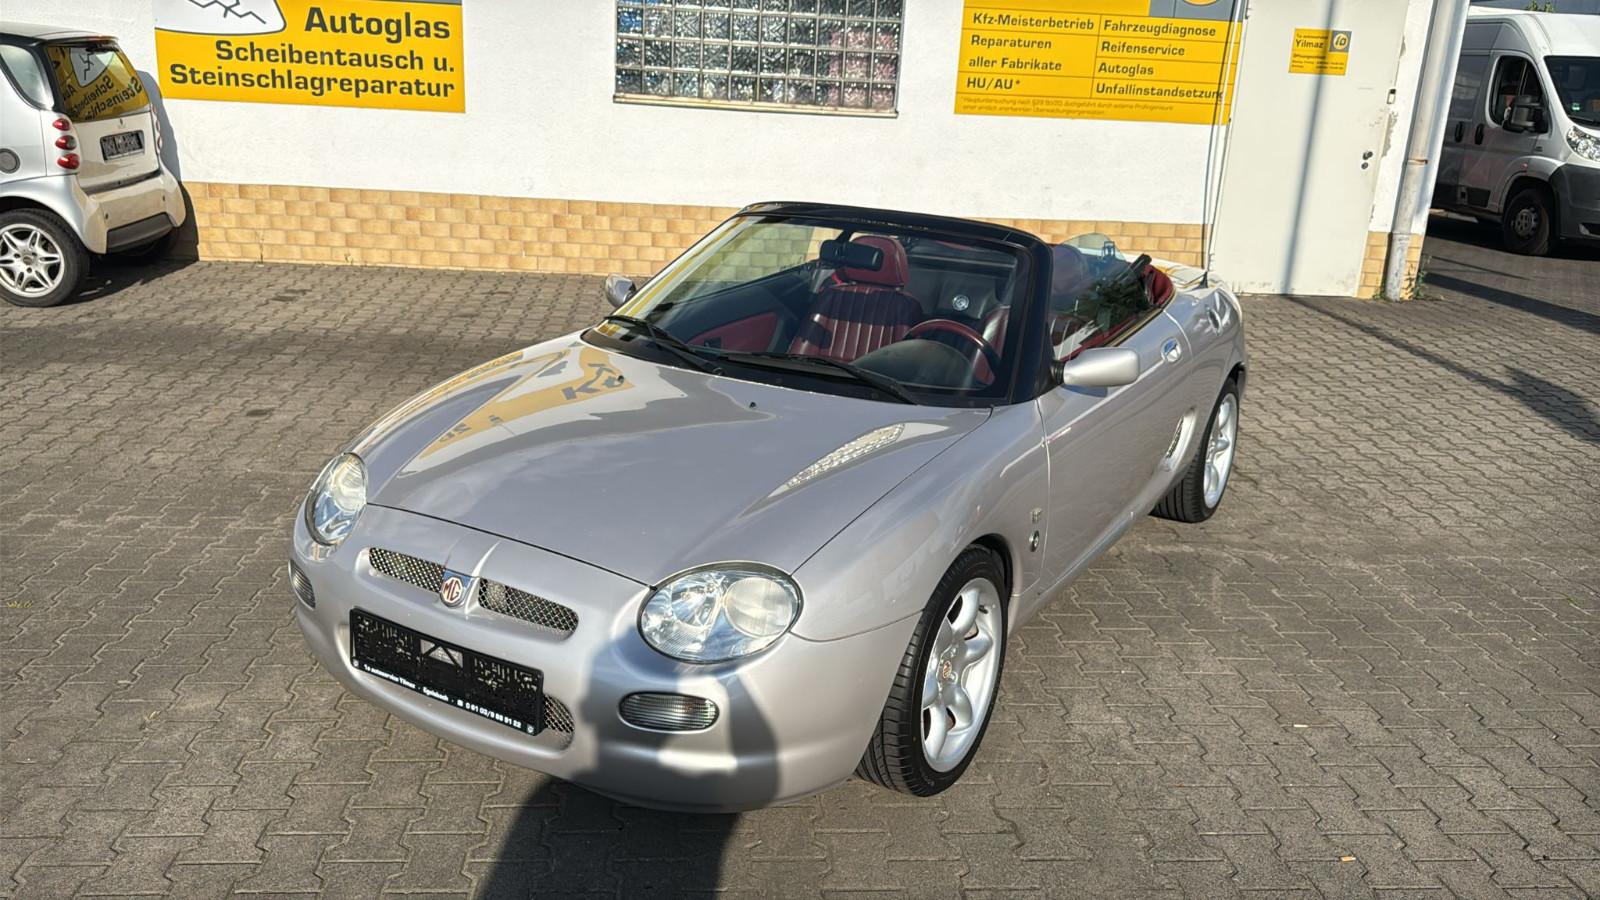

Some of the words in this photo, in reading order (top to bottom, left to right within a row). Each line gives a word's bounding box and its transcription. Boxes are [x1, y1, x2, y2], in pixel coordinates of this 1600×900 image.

[304, 7, 450, 43] Autoglas
[973, 12, 1094, 30] Kfz-Meisterbetrieb
[1104, 19, 1216, 38] Fahrzeugdiagnose
[971, 34, 1052, 49] Reparaturen
[1101, 41, 1185, 56] Reifenservice
[1295, 39, 1324, 48] Yilmaz
[215, 40, 424, 71] Scheibentausch
[433, 54, 455, 72] u.
[969, 56, 997, 68] aller
[1001, 57, 1062, 71] Fabrikate
[1098, 62, 1154, 77] Autoglas
[170, 63, 455, 98] Steinschlagreparatur
[443, 579, 462, 602] MG
